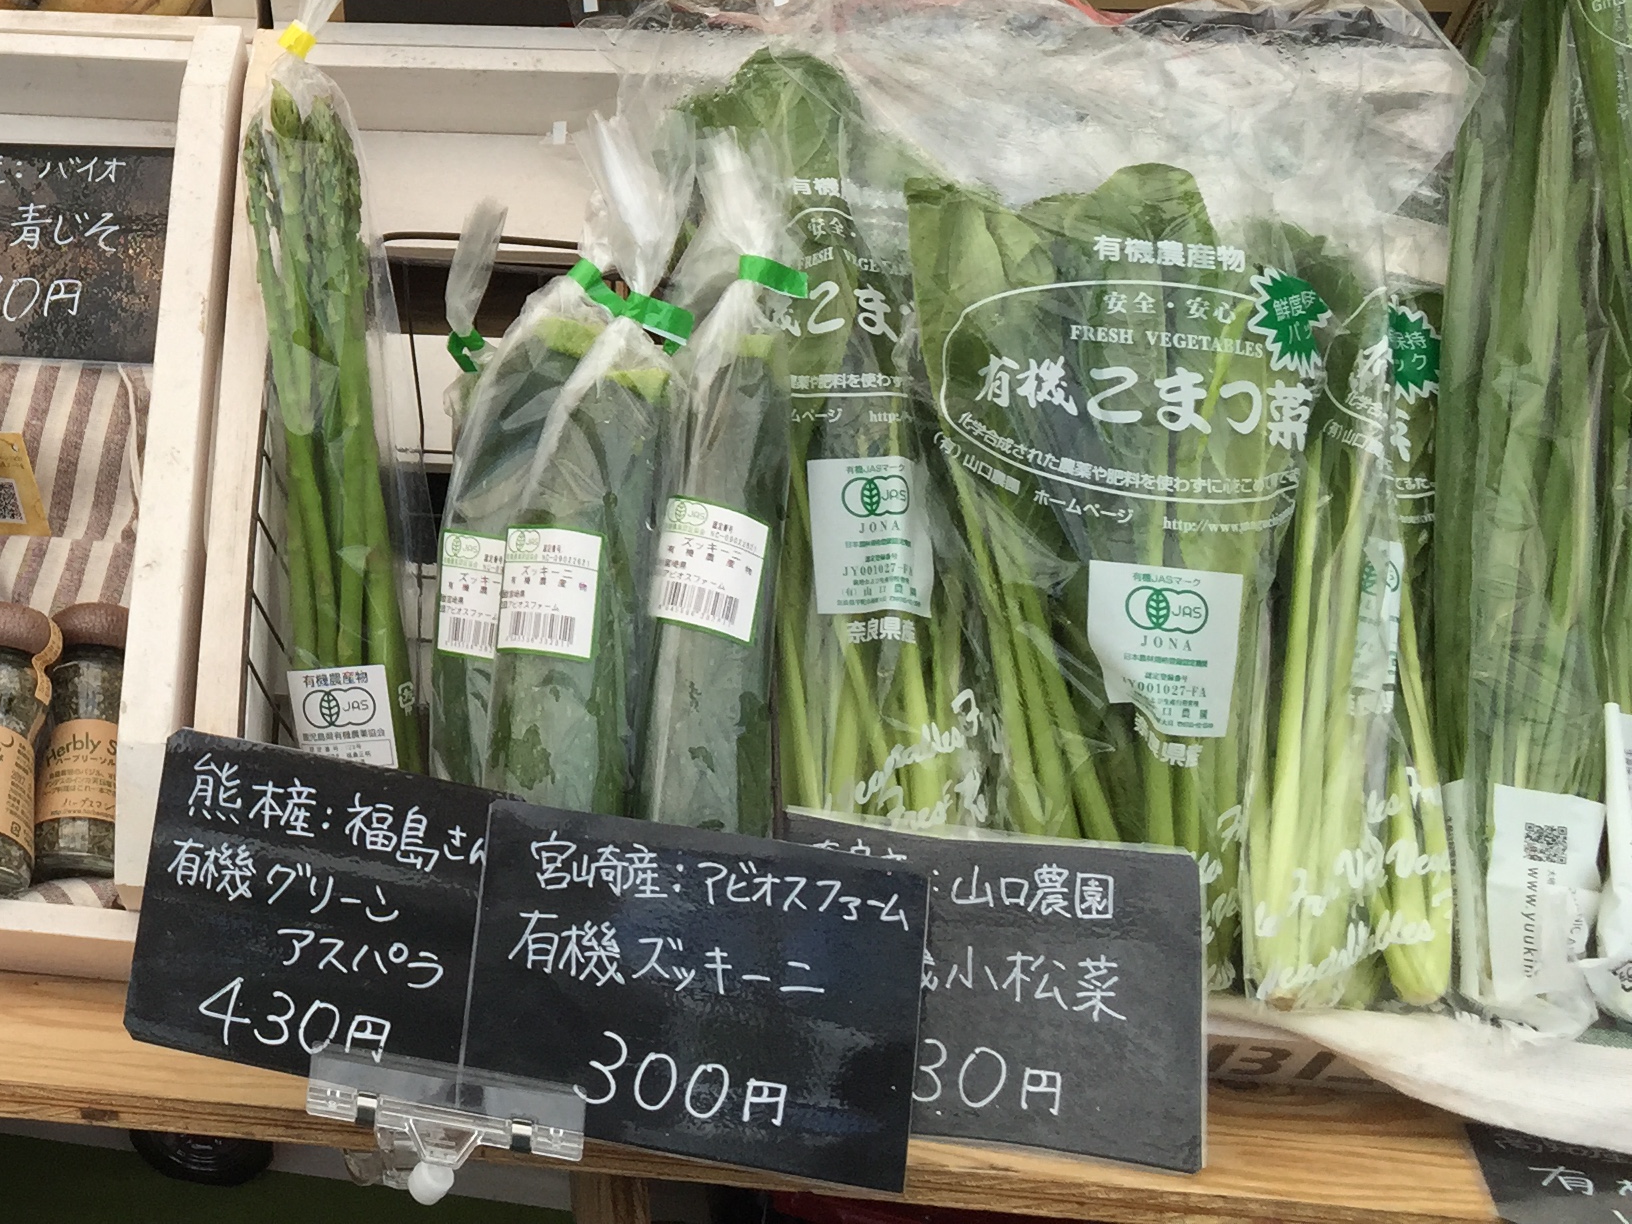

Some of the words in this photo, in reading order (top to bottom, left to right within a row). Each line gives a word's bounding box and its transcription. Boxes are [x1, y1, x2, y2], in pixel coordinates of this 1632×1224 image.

[1094, 234, 1246, 272] 有機農産物
[1070, 324, 1135, 347] FRESH
[1145, 330, 1264, 359] VEGETABLES
[846, 464, 906, 474] 有機JASマーク
[880, 489, 907, 502] JAS
[1033, 489, 1134, 524] ホームページ
[859, 521, 901, 534] JONA
[682, 537, 742, 561] ズッキーニ
[521, 565, 573, 579] ズッキーニ
[1133, 572, 1201, 587] 有機JASマーク
[1171, 606, 1202, 619] JAS
[848, 617, 917, 644] 奈良県産
[1141, 635, 1192, 652] JONA
[303, 670, 369, 688] 有機農産物
[342, 700, 369, 712] JAS
[46, 731, 102, 768] Herbly
[168, 838, 399, 923] 有機グリーン
[277, 928, 444, 988] アスパラ
[508, 910, 825, 995] 有機ズッキーニ
[198, 977, 392, 1063] 430円
[573, 1030, 788, 1127] 300円
